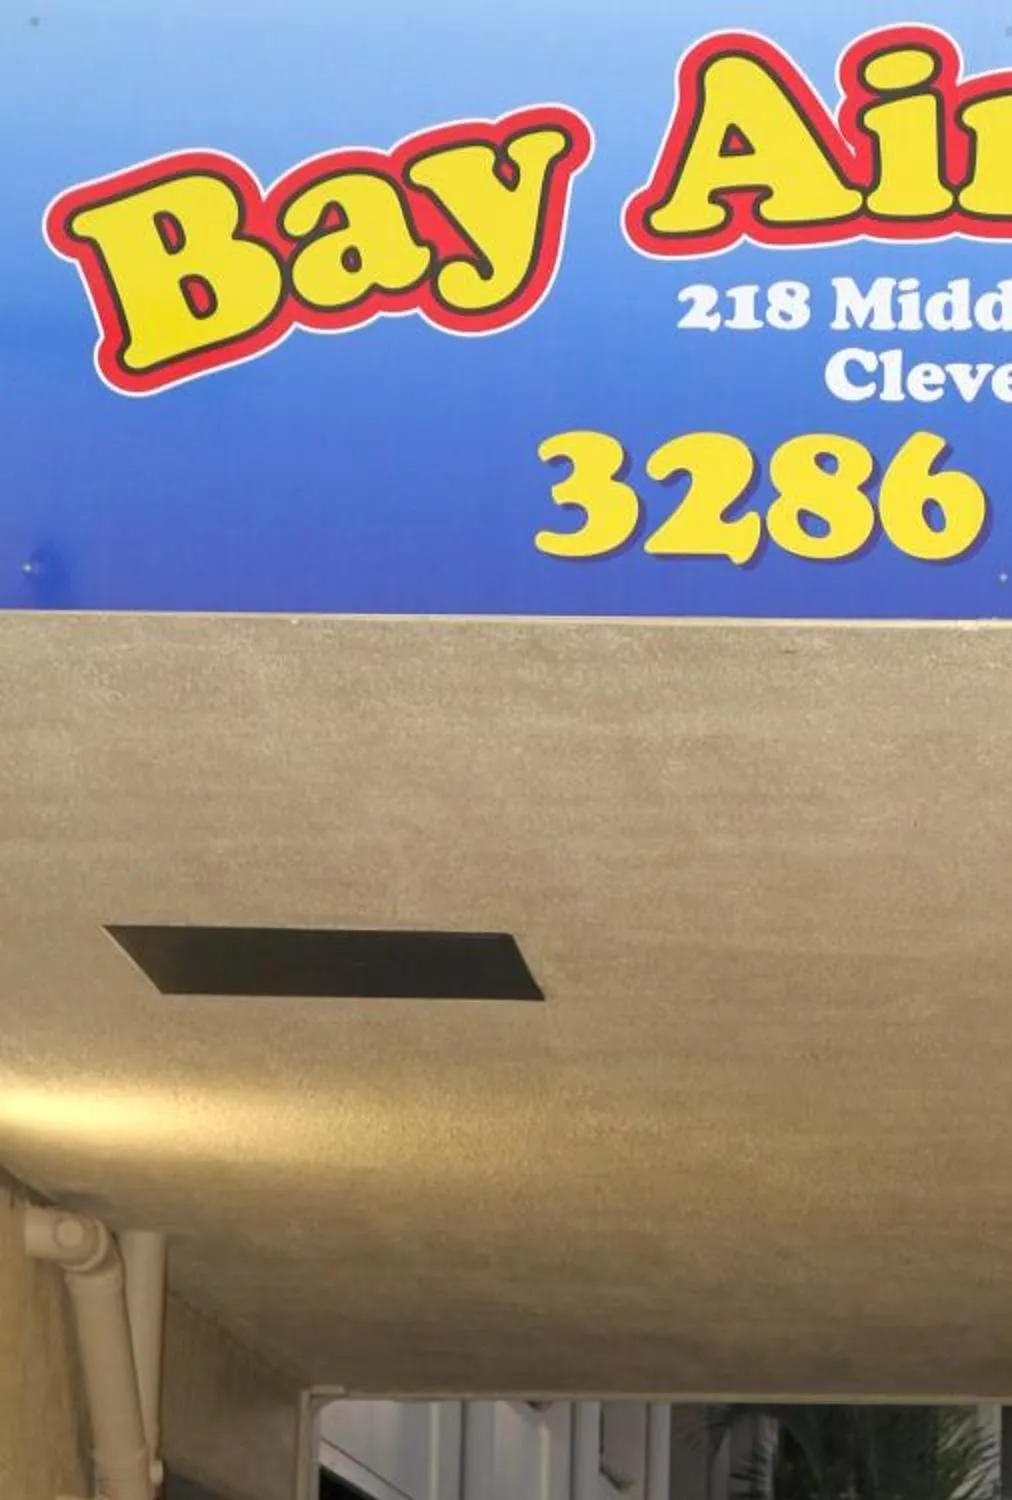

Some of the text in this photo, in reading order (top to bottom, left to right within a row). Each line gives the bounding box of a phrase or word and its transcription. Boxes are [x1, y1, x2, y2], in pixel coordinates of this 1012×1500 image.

[66, 124, 571, 376] Bay
[676, 284, 812, 333] 218
[534, 430, 990, 566] 3286
